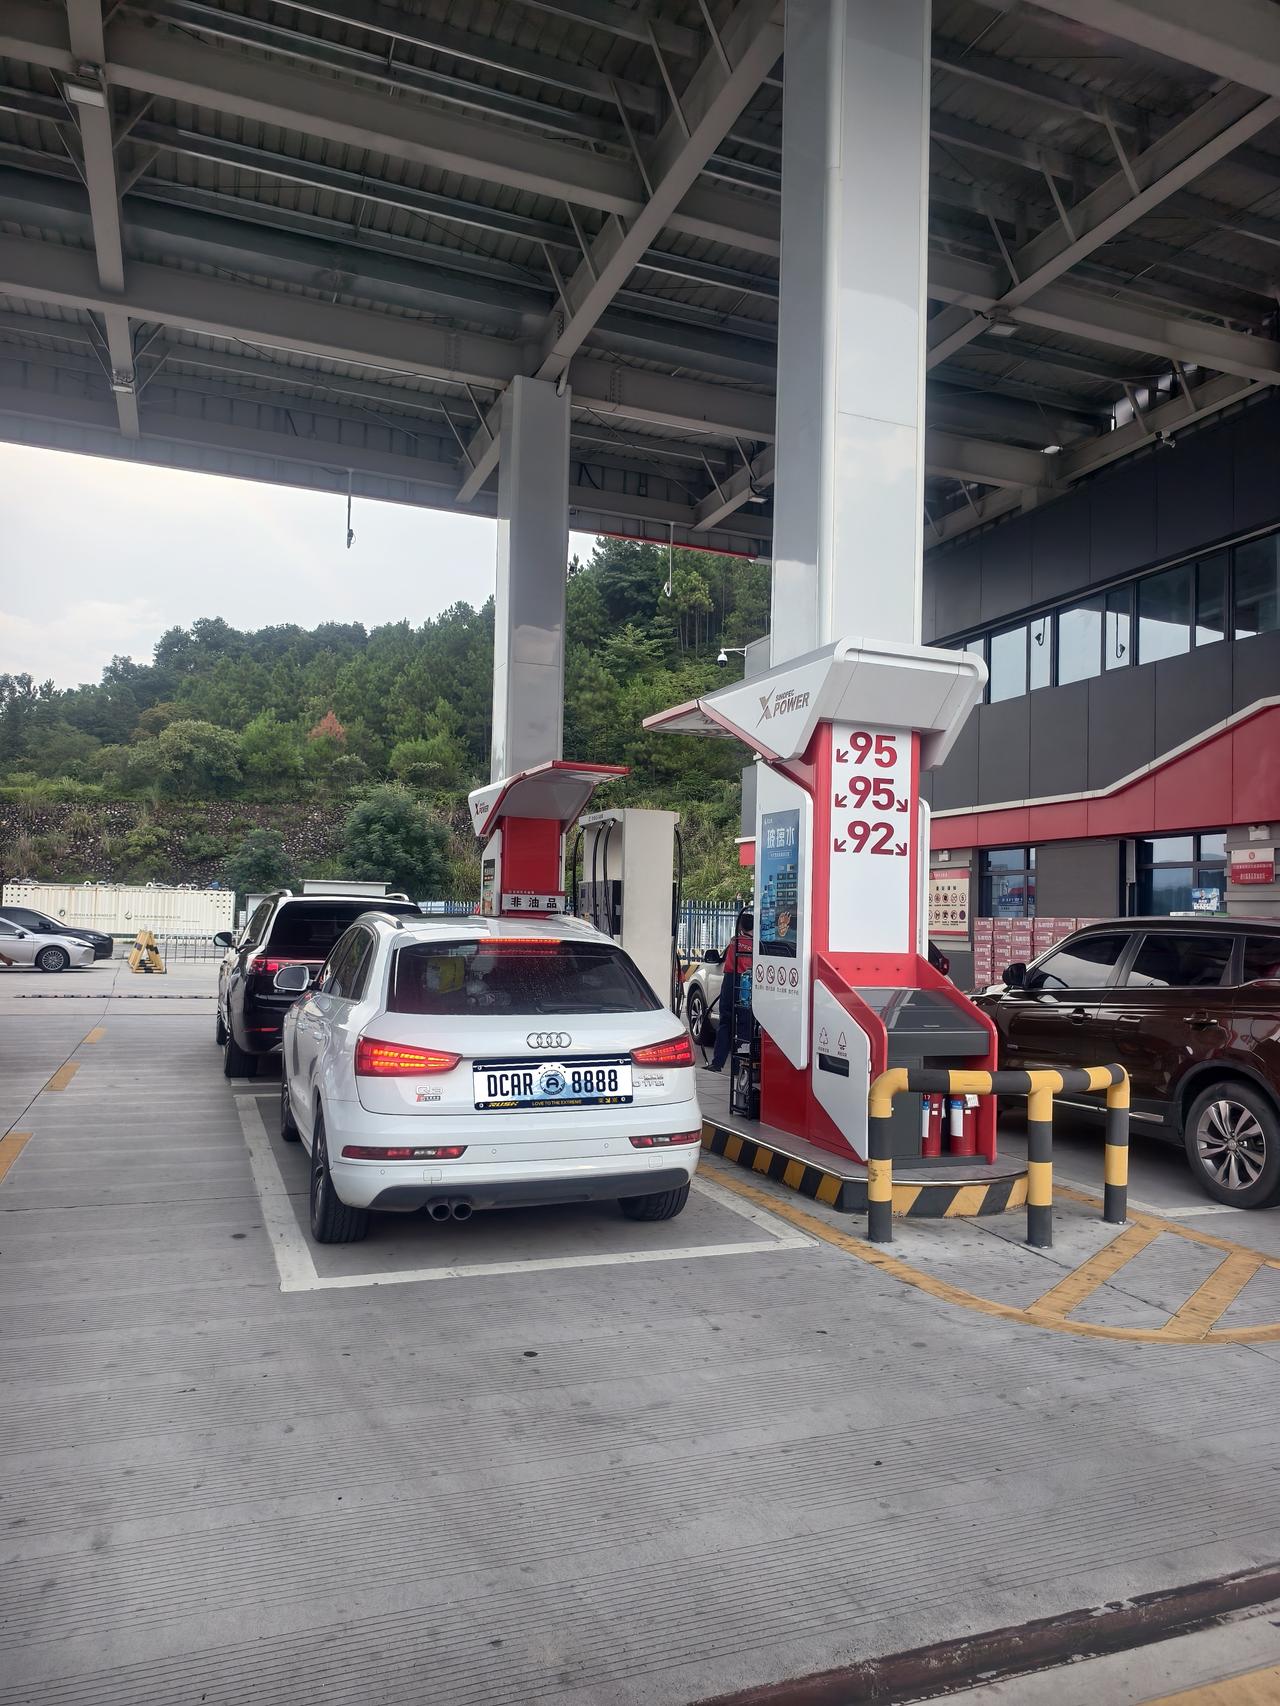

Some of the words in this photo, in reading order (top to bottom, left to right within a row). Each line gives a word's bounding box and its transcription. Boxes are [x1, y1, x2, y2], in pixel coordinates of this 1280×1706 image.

[773, 692, 810, 717] POWER
[850, 731, 897, 768] 95
[848, 776, 895, 810] 95
[847, 820, 895, 855] 92
[510, 896, 557, 908] 非油品
[487, 1073, 533, 1097] DCAR
[572, 1069, 618, 1093] 8888
